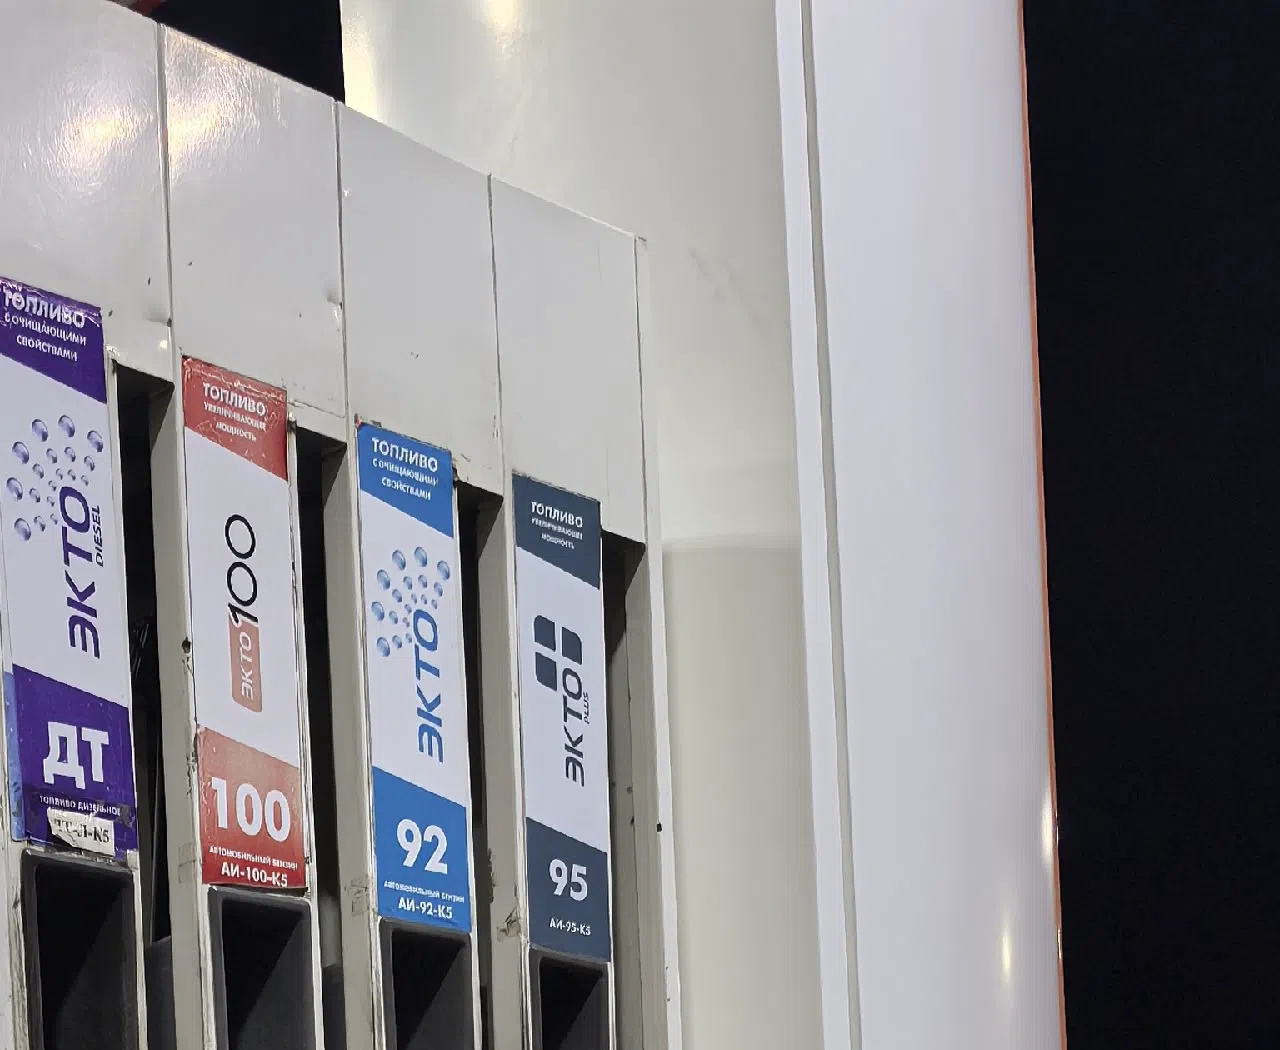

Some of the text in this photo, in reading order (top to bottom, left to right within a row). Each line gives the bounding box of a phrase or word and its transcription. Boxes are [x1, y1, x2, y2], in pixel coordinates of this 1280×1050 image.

[3, 286, 86, 329] ТОПЛИВО
[12, 315, 87, 346] ОЧИЩАЮЩИМИ
[16, 334, 78, 361] СВОЙСТВАМИ
[203, 381, 266, 417] ТОПЛИВО
[371, 436, 438, 472] ТОПЛИВО
[381, 477, 431, 500] СВОЙСТВАМИ
[531, 501, 583, 528] ТОПЛИВО
[91, 504, 104, 568] DIESEL
[59, 486, 101, 660] ЭКТО
[225, 514, 259, 625] 100
[413, 609, 444, 764] ЭКТО
[582, 691, 590, 725] PLUS
[562, 668, 585, 787] ЭКТО
[43, 721, 109, 789] ДТ
[40, 795, 76, 808] ТОПЛИВО
[211, 776, 291, 842] 100
[209, 845, 271, 866] АВТОМОБИЛЬНЫЙ
[396, 818, 448, 875] 92
[221, 861, 288, 887] АИ-100-К5
[549, 858, 588, 901] 95
[398, 896, 453, 919] АИ-92-К5
[550, 917, 592, 936] АИ-95-К5
